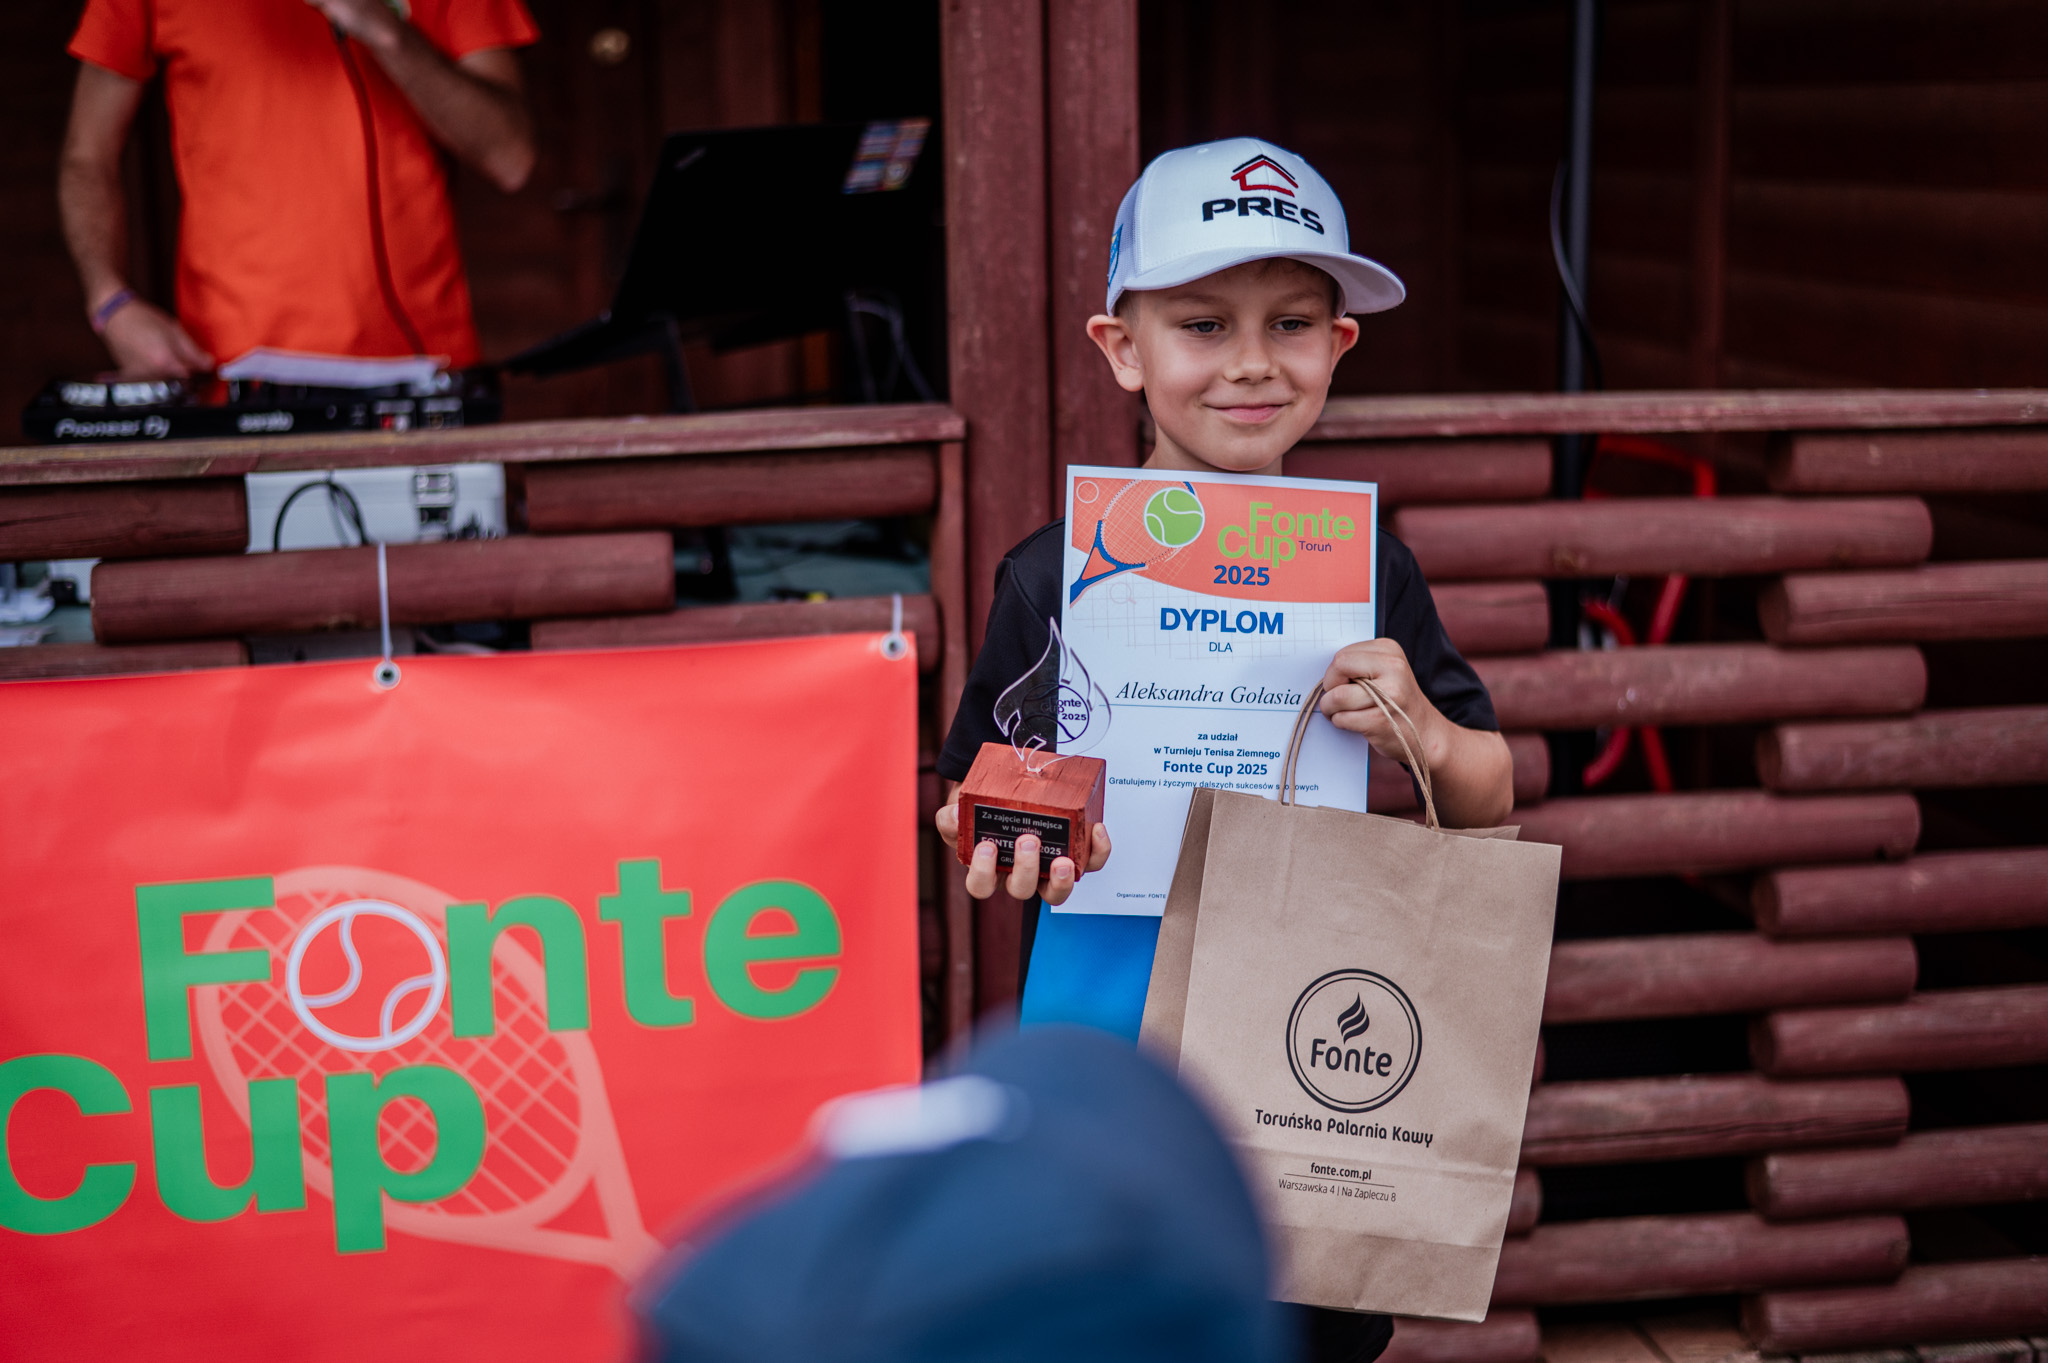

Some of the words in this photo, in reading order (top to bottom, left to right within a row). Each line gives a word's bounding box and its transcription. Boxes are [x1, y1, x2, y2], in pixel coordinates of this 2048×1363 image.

[1202, 196, 1325, 235] PRES
[54, 417, 142, 438] Pioneer
[1249, 501, 1356, 541] Fonte
[1217, 524, 1298, 569] Cup
[1298, 540, 1332, 552] Toruń
[1213, 565, 1270, 587] 2025
[1160, 607, 1284, 635] DYPLOM
[1209, 641, 1233, 653] DLA
[1115, 681, 1224, 703] Aleksandra
[1230, 685, 1302, 705] Gołasia
[1061, 713, 1087, 721] 2025
[1197, 733, 1208, 741] za
[1210, 732, 1238, 741] udział
[1163, 746, 1202, 757] Turnieju
[1204, 748, 1234, 757] Tenisa
[1236, 748, 1281, 759] Ziemnego
[1163, 760, 1203, 773] Fonte
[1206, 762, 1233, 777] Cup
[1236, 763, 1268, 776] 2025
[1108, 776, 1157, 788] Gratulujemy
[1163, 779, 1198, 789] życzymy
[1199, 780, 1234, 789] dalszych
[1235, 781, 1274, 790] sukcesów
[1275, 783, 1319, 792] soowych
[981, 811, 992, 819] Za
[993, 814, 1021, 824] zajęcie
[1022, 817, 1031, 825] III
[1032, 820, 1063, 830] miejsca
[1011, 825, 1042, 836] turnieju
[135, 857, 844, 1062] Fonte
[1310, 1037, 1393, 1077] Fonte
[1255, 1108, 1322, 1132] Toruńska
[1327, 1117, 1387, 1140] Palarnia
[1392, 1126, 1434, 1148] Kawy
[1310, 1162, 1372, 1181] fonte.com.pl
[1278, 1178, 1328, 1194] Warszawska
[1329, 1185, 1335, 1194] 4
[1341, 1186, 1353, 1197] Na
[1390, 1192, 1397, 1202] 8
